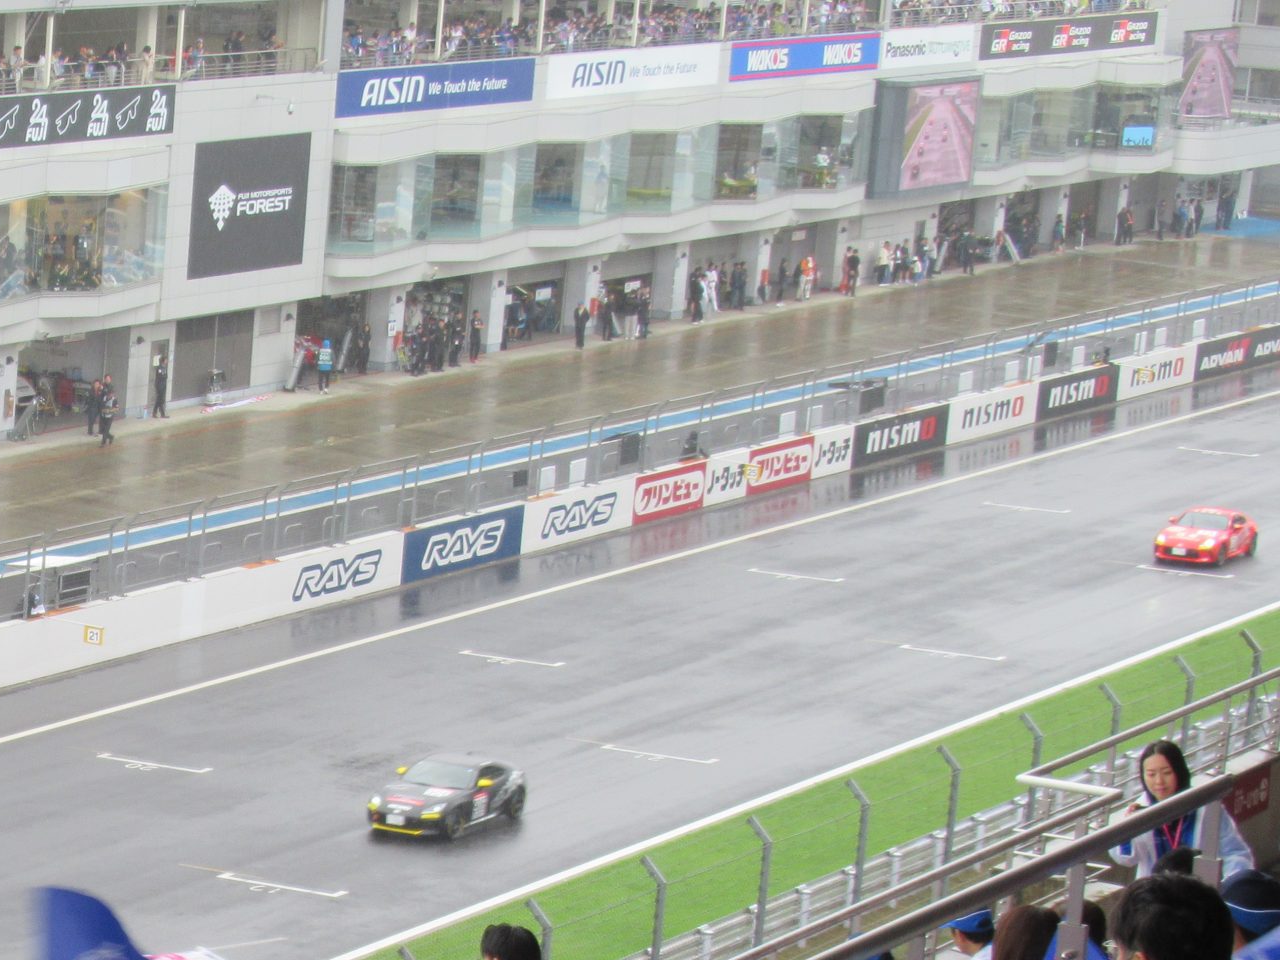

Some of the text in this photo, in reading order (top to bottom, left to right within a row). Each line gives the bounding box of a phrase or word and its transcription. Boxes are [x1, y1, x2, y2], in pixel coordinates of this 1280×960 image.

[885, 39, 927, 58] Panasonic
[571, 60, 698, 88] AISIN We Touch the Future
[360, 75, 507, 107] AISIN We Touch the Future
[236, 195, 292, 217] FOREST
[250, 187, 293, 199] MOTORSPORTS
[1200, 347, 1244, 371] ADVAN
[641, 478, 699, 511] クリンビュー
[542, 492, 617, 539] RAYS
[421, 519, 506, 570] RAYS
[292, 549, 382, 601] RAYS
[89, 631, 99, 642] 21
